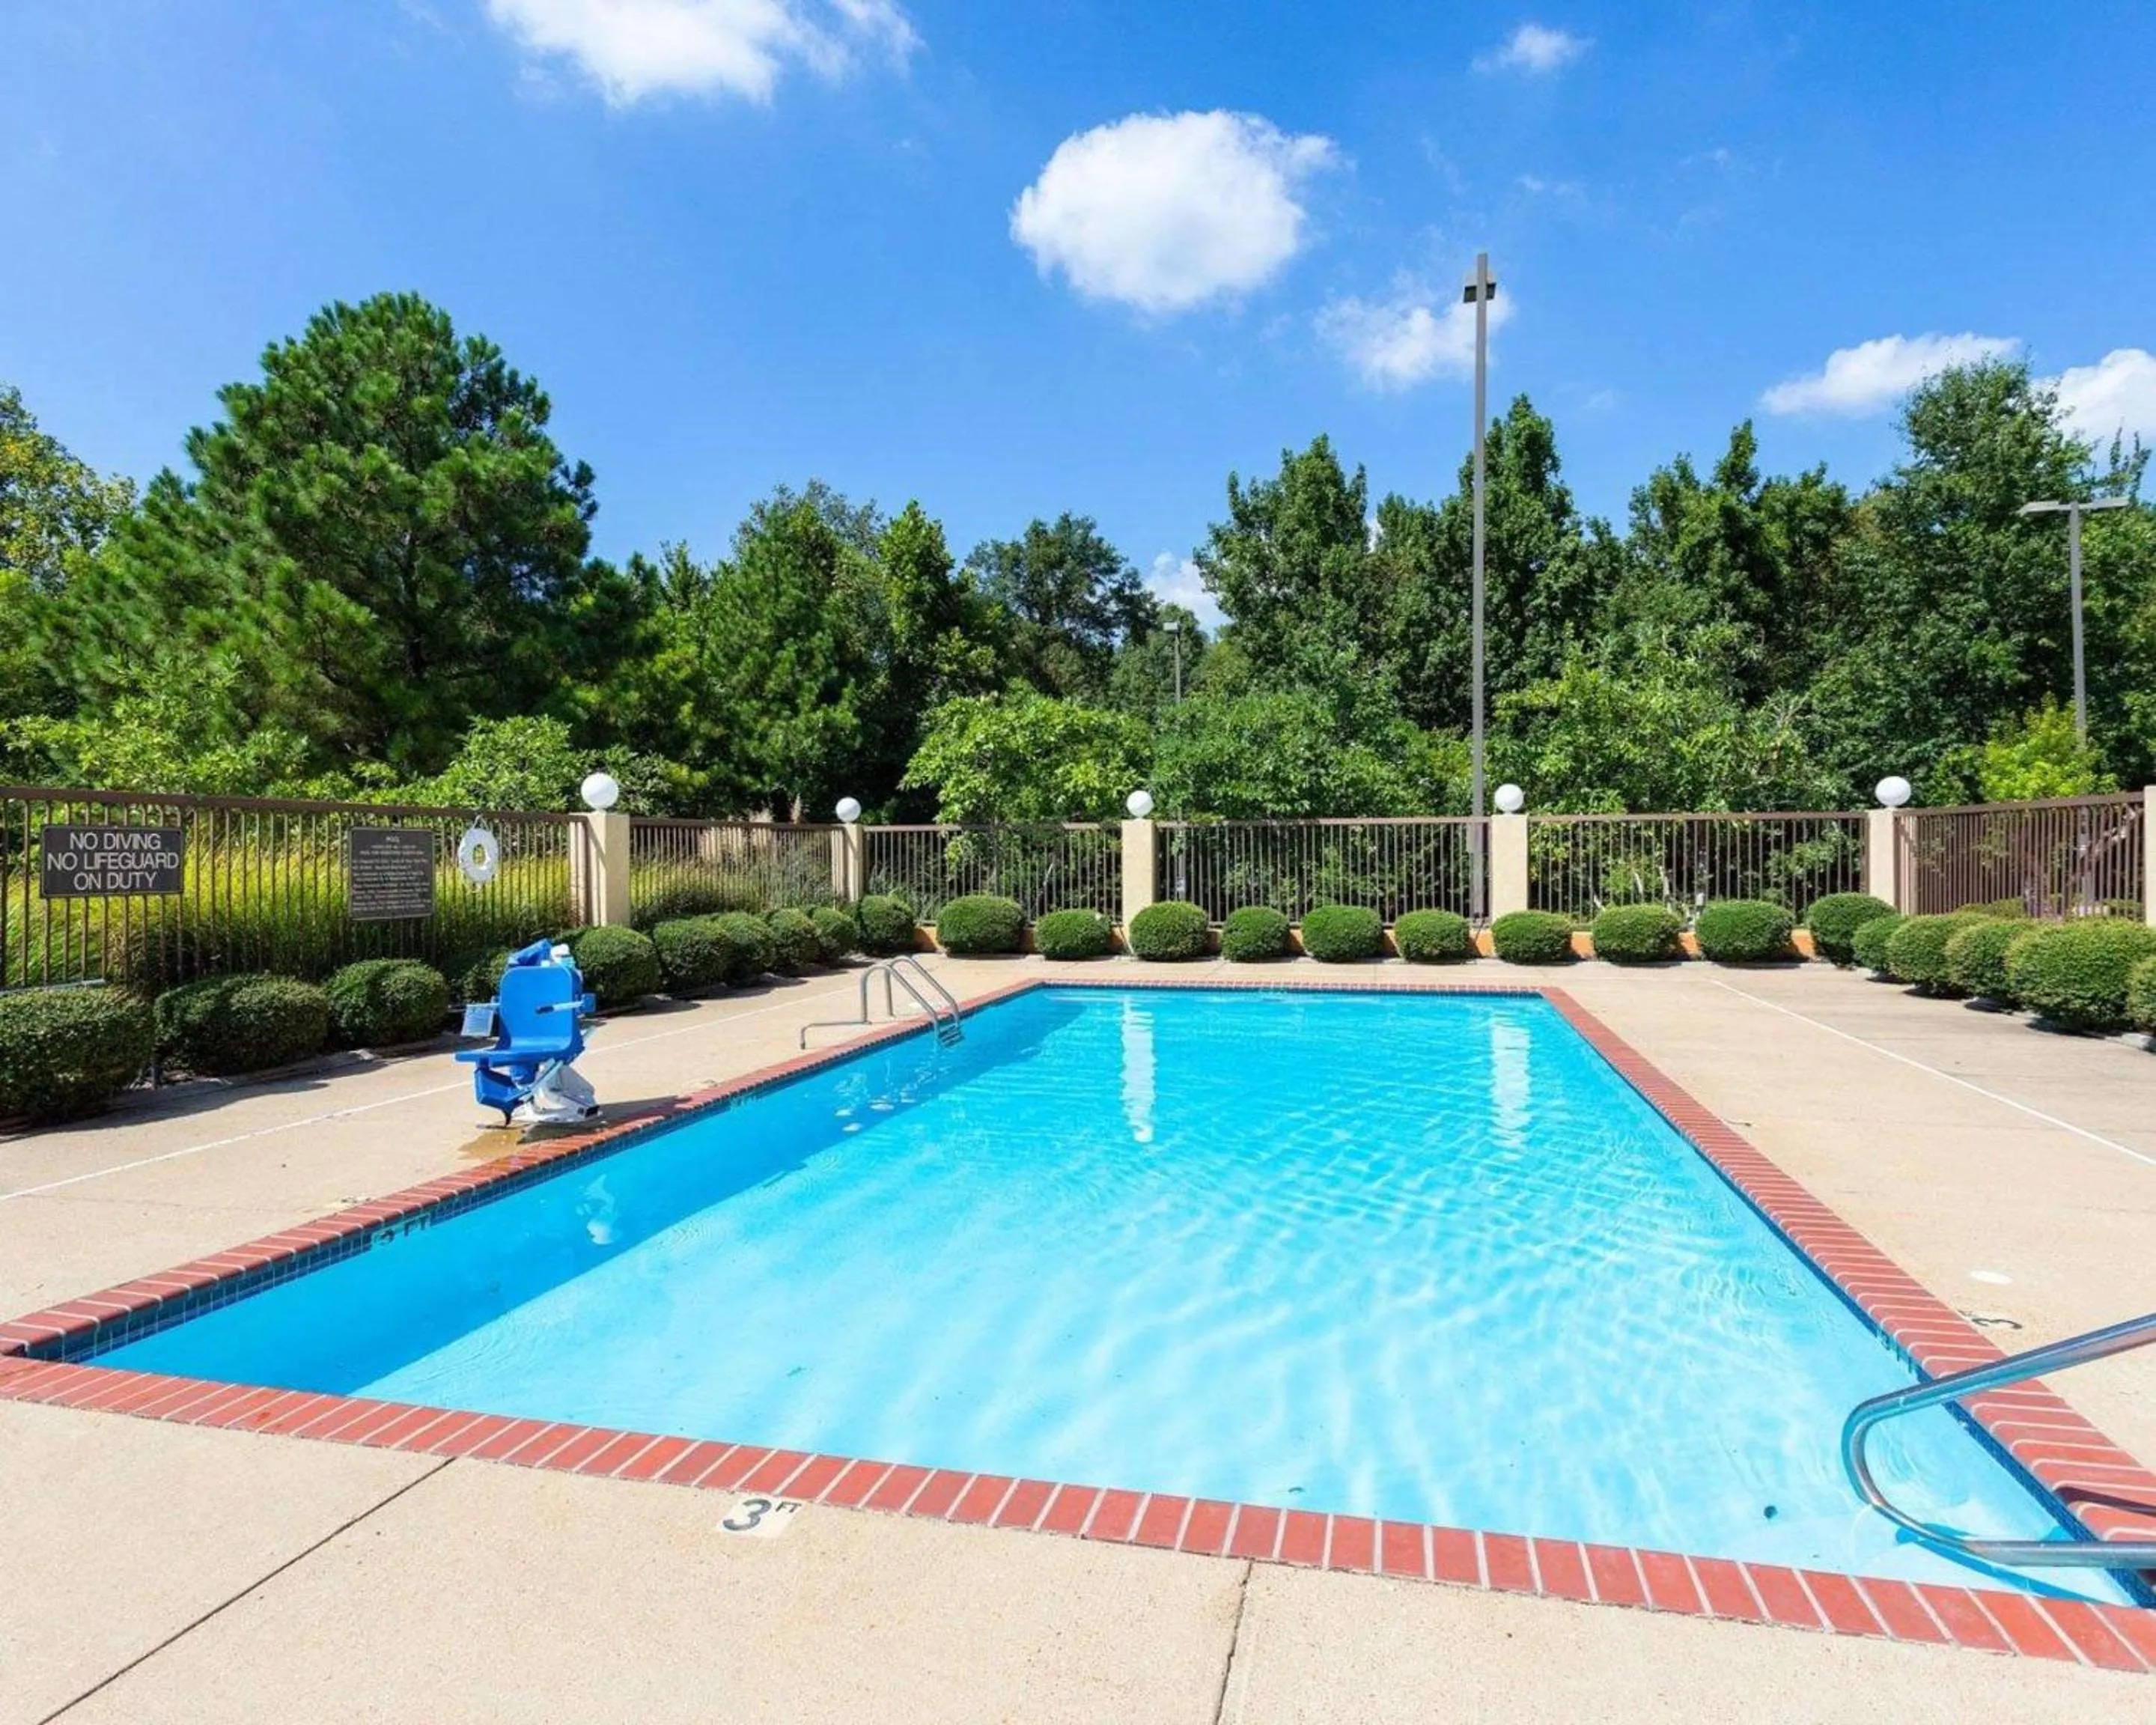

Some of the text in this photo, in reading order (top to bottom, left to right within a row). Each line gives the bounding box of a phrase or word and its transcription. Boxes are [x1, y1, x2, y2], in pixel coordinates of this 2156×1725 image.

[70, 832, 162, 851] NO DIVING
[46, 852, 179, 871] NO LIFEGUARD
[73, 871, 157, 890] ON DUTY
[722, 1498, 802, 1531] 3 FT
